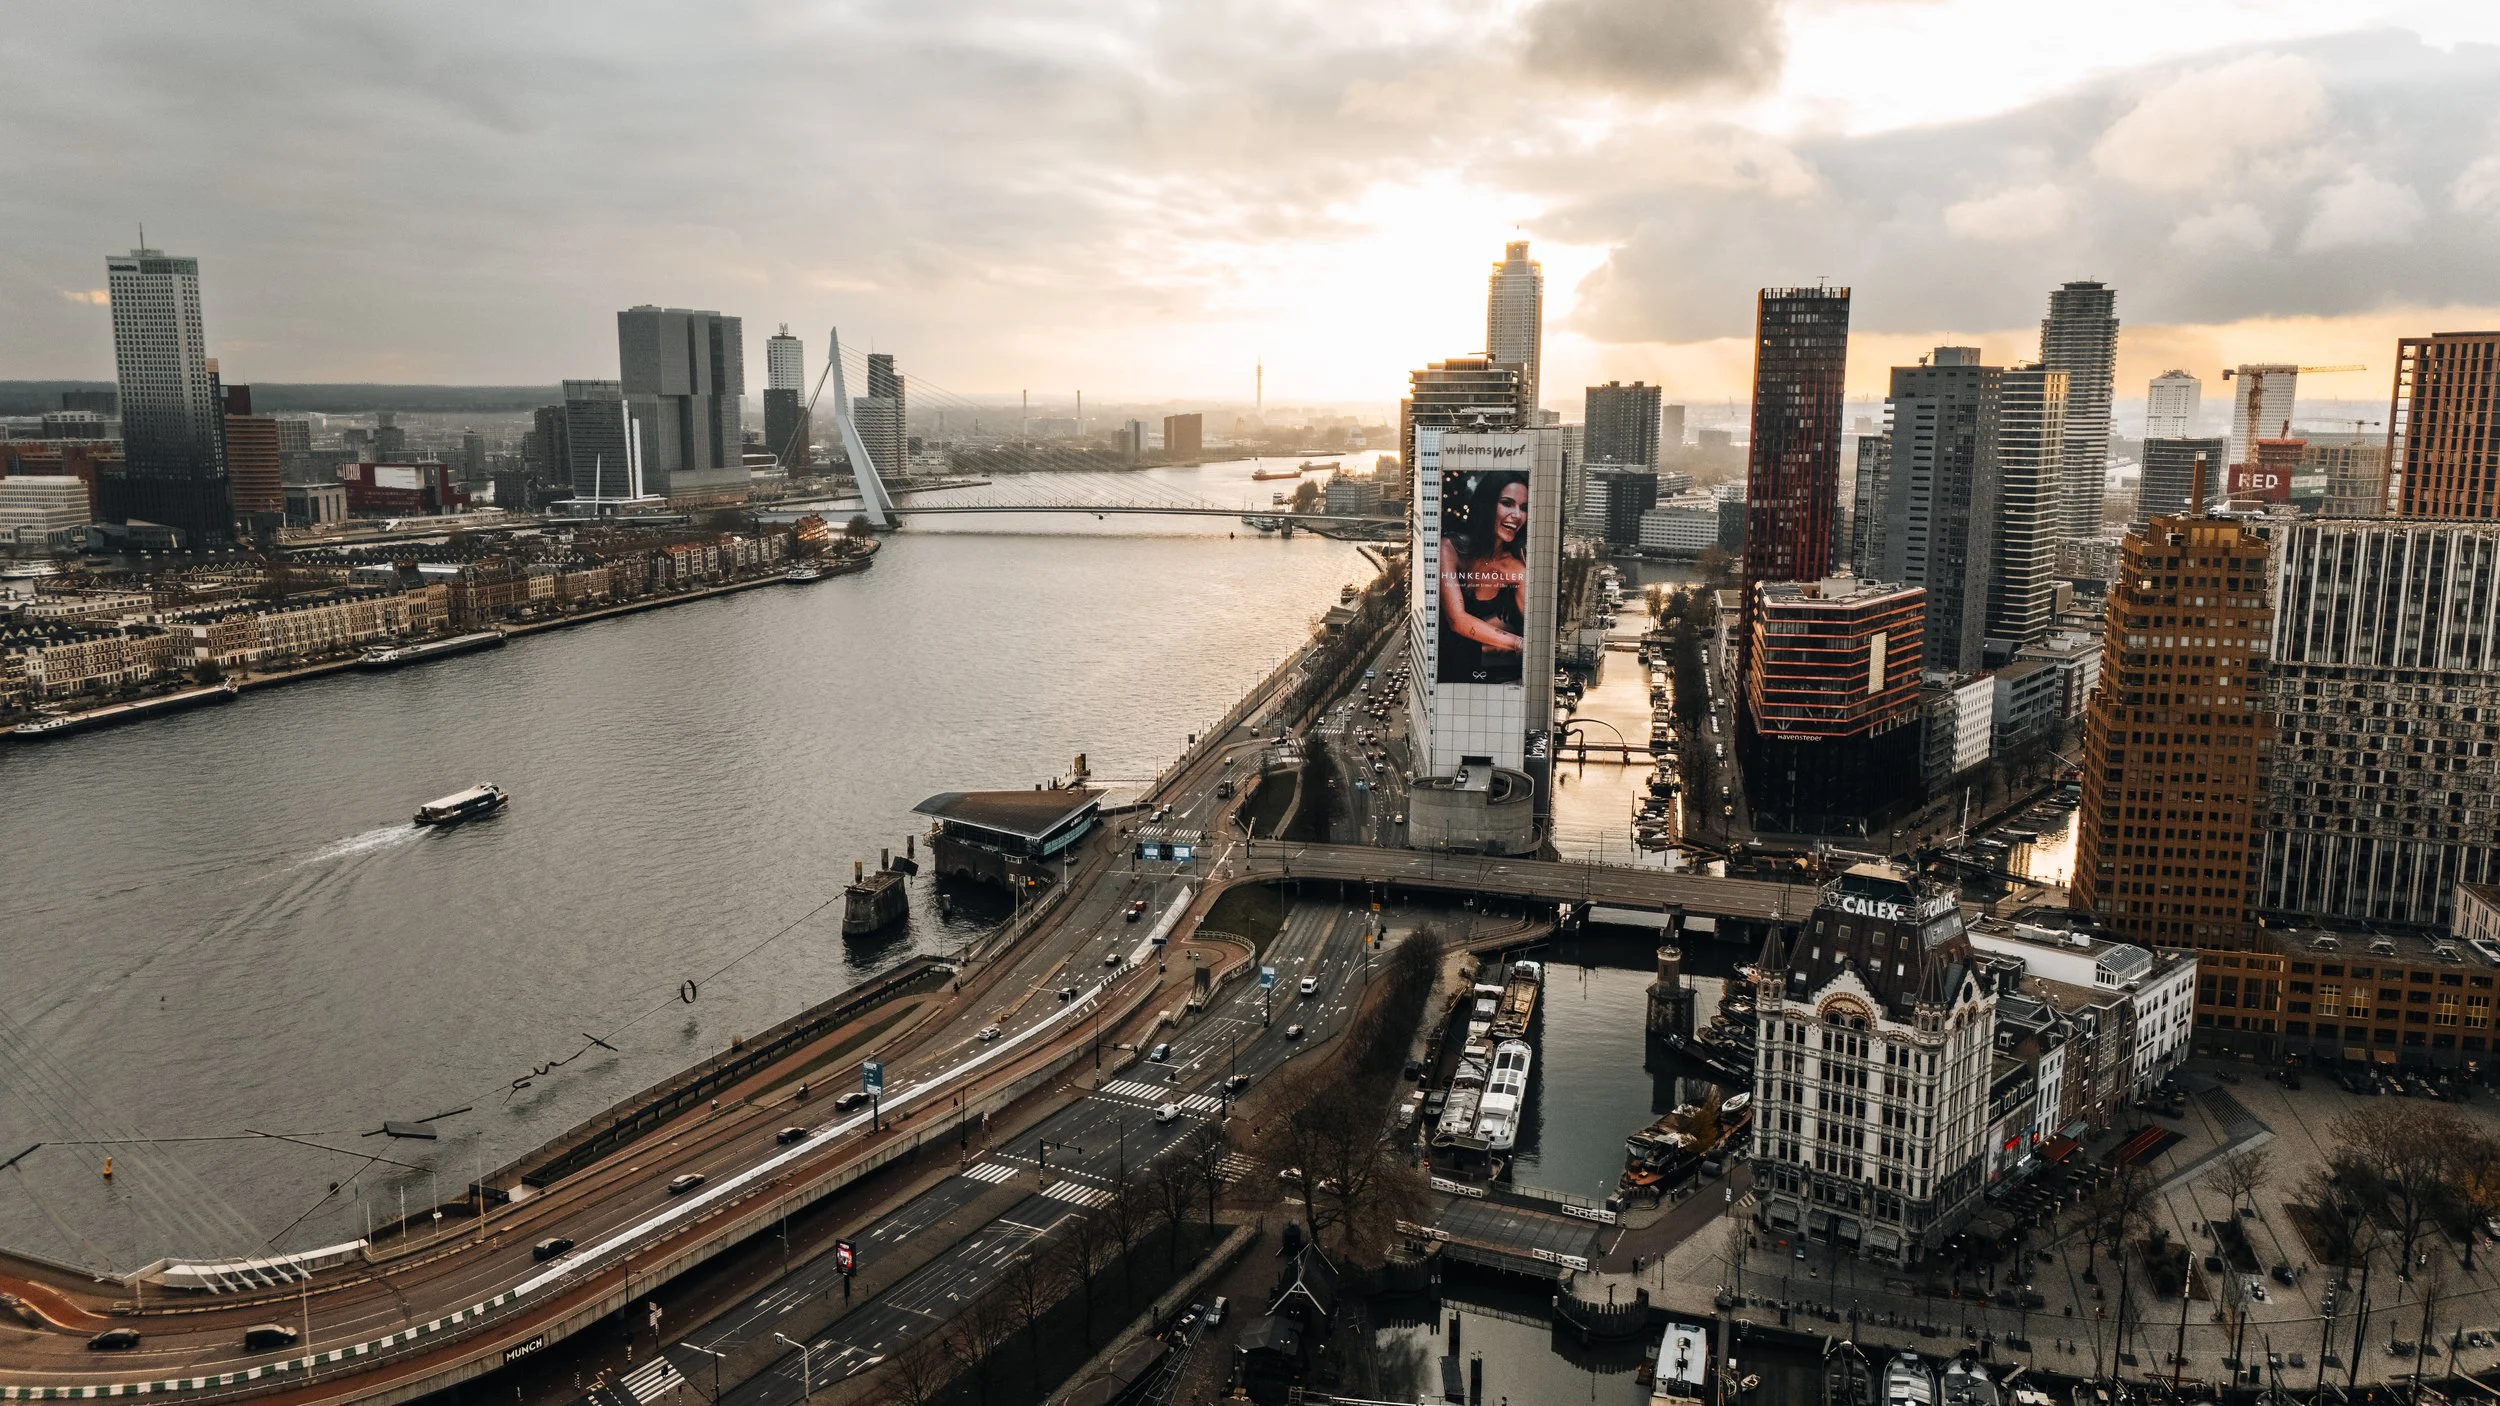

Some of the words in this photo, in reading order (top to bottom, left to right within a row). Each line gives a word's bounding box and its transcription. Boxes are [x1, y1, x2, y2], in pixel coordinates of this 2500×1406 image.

[1441, 571, 1524, 581] HUNKEMÖLLER
[1842, 896, 1898, 921] CALEX
[506, 1337, 543, 1363] MUNCH
